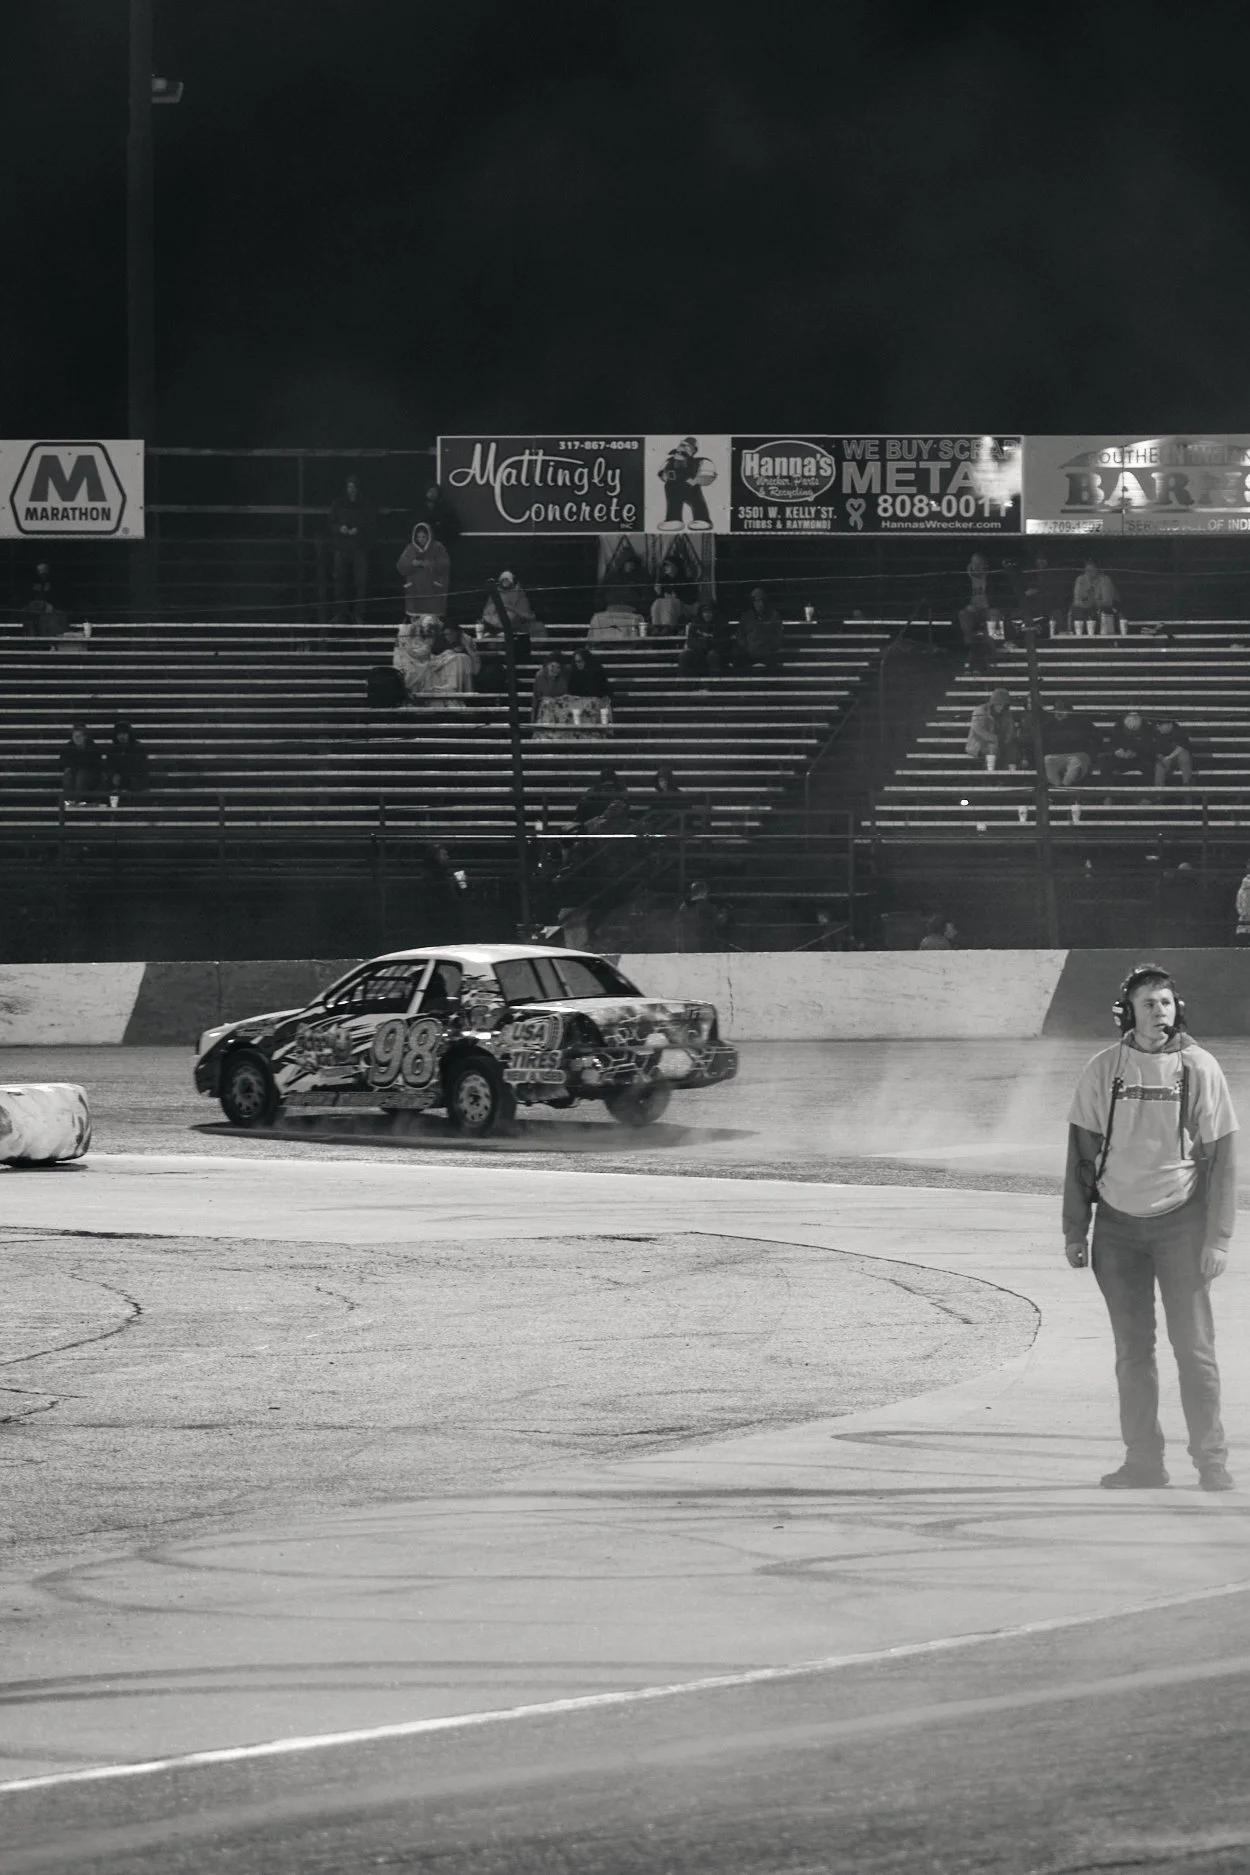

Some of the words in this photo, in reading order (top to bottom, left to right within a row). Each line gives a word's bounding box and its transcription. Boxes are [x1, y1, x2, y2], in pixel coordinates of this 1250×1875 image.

[842, 440, 880, 459] WE
[886, 440, 934, 459] BUY
[29, 455, 107, 502] M
[449, 441, 621, 496] Mattingly
[744, 453, 833, 477] Hanna's
[842, 461, 984, 494] META
[494, 472, 636, 524] Concrete
[738, 506, 764, 518] 3501
[768, 507, 781, 518] W.
[785, 507, 817, 518] KELLY
[820, 507, 837, 518] ST.
[24, 507, 111, 521] MARATHON
[881, 520, 1001, 529] HannasWrecker.com
[368, 1018, 443, 1089] 98
